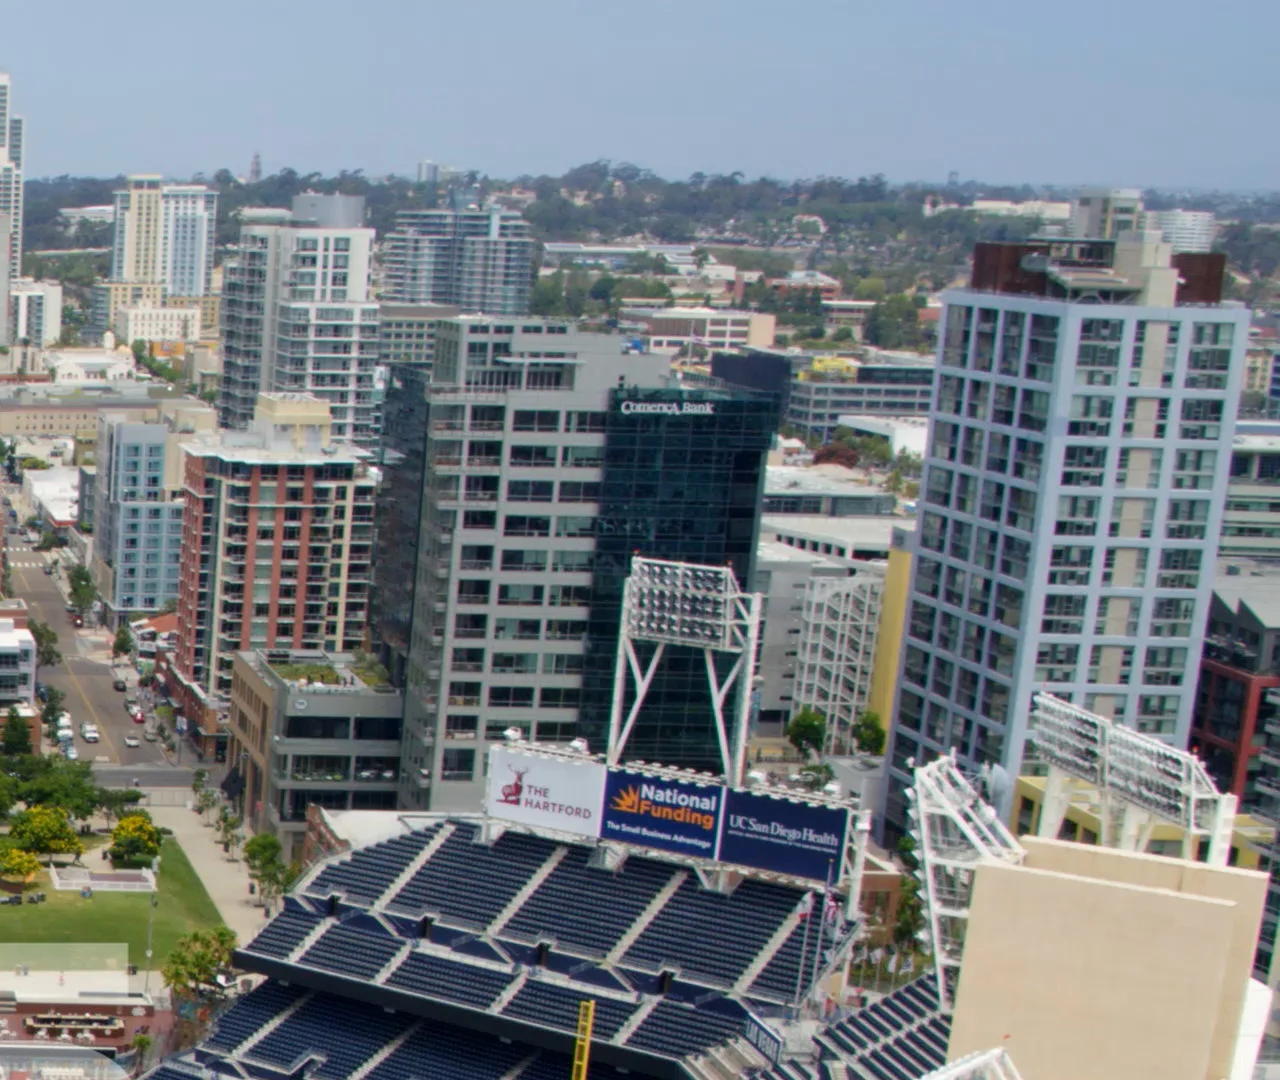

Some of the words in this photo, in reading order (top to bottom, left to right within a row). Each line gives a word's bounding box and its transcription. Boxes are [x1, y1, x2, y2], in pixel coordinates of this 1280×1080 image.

[682, 402, 714, 414] Bank
[527, 785, 550, 798] THE
[641, 784, 716, 811] National
[524, 797, 592, 819] HARTFORD
[639, 800, 714, 831] Funding
[729, 814, 748, 829] UC
[749, 817, 770, 834] San
[770, 822, 802, 841] Diego
[803, 827, 838, 847] Health
